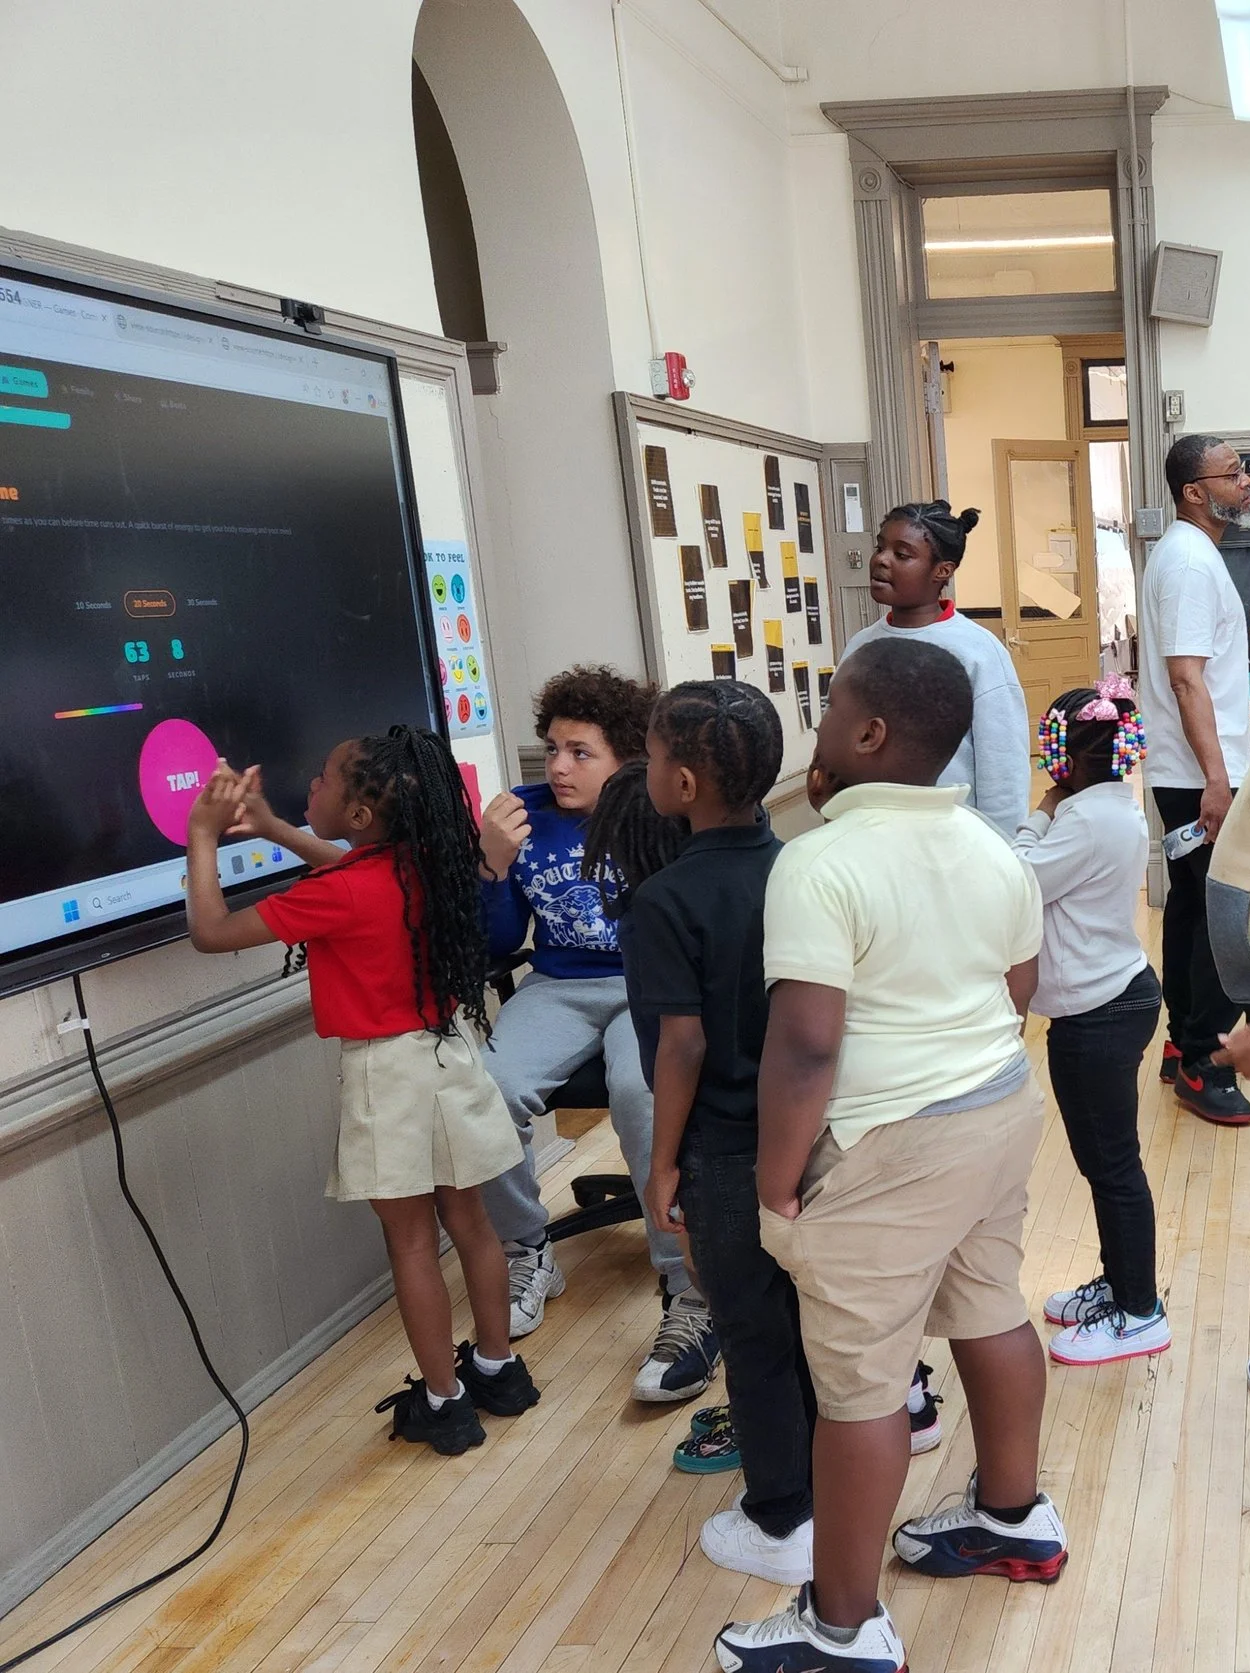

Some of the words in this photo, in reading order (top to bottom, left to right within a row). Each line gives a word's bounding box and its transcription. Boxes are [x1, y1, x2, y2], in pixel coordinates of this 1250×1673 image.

[13, 377, 38, 388] Games
[75, 601, 85, 610] 10
[85, 600, 112, 610] Seconds
[133, 600, 142, 608] 20
[142, 599, 167, 608] Seconds
[196, 598, 218, 607] Seconds
[124, 641, 150, 663] 63
[171, 639, 184, 660] 8
[167, 670, 196, 679] SECONDS
[166, 770, 200, 792] TAP!
[106, 888, 132, 906] Search
